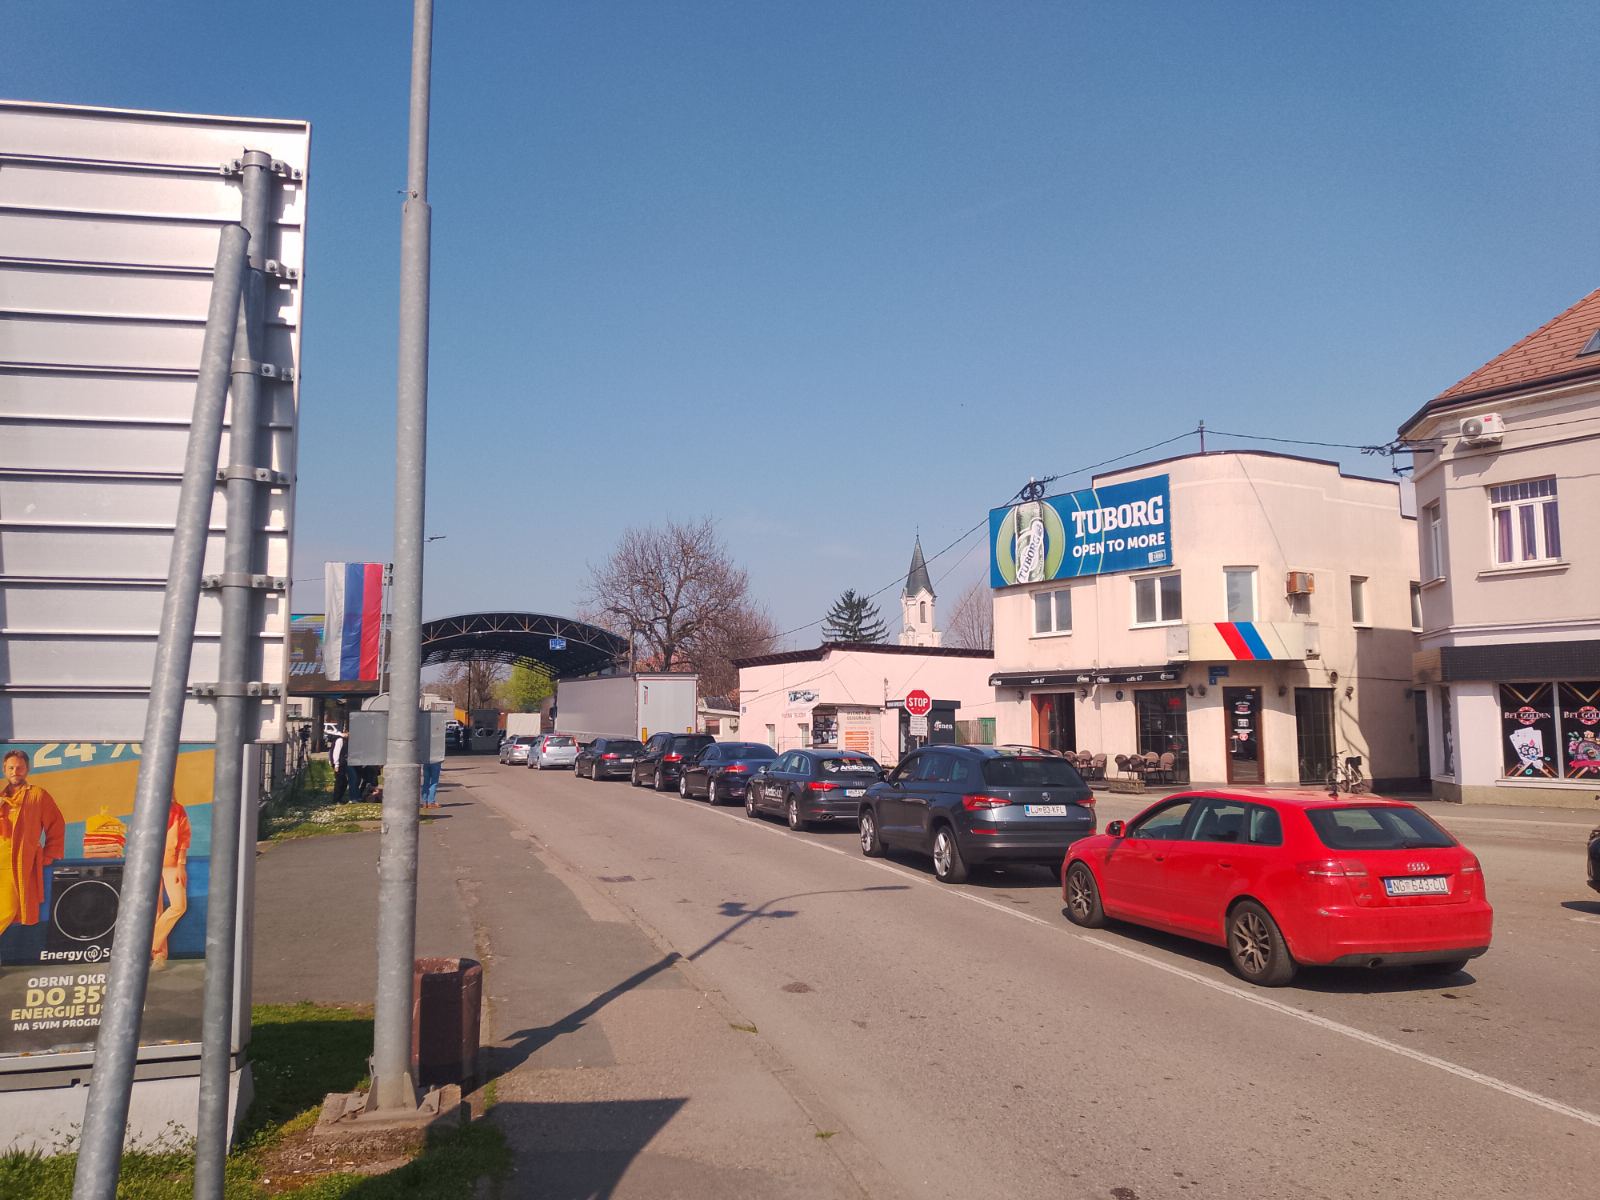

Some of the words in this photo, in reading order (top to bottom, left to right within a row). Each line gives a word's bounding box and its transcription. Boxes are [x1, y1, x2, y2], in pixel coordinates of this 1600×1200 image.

[1072, 495, 1164, 538] TUBORG
[1072, 542, 1104, 557] OPEN
[1106, 538, 1124, 552] TO
[1127, 532, 1165, 549] MORE
[1019, 535, 1041, 578] TUBORG
[908, 697, 928, 707] STOP
[1393, 881, 1405, 892] NG
[40, 950, 83, 961] Energy
[103, 948, 112, 958] S
[28, 976, 74, 988] OBRNI
[78, 974, 106, 985] OKR
[26, 988, 66, 1007] DO
[73, 986, 106, 1004] 35
[11, 1005, 85, 1020] ENERGIJE
[89, 1004, 103, 1016] U
[14, 1023, 30, 1031] NA
[32, 1021, 60, 1030] SVIM
